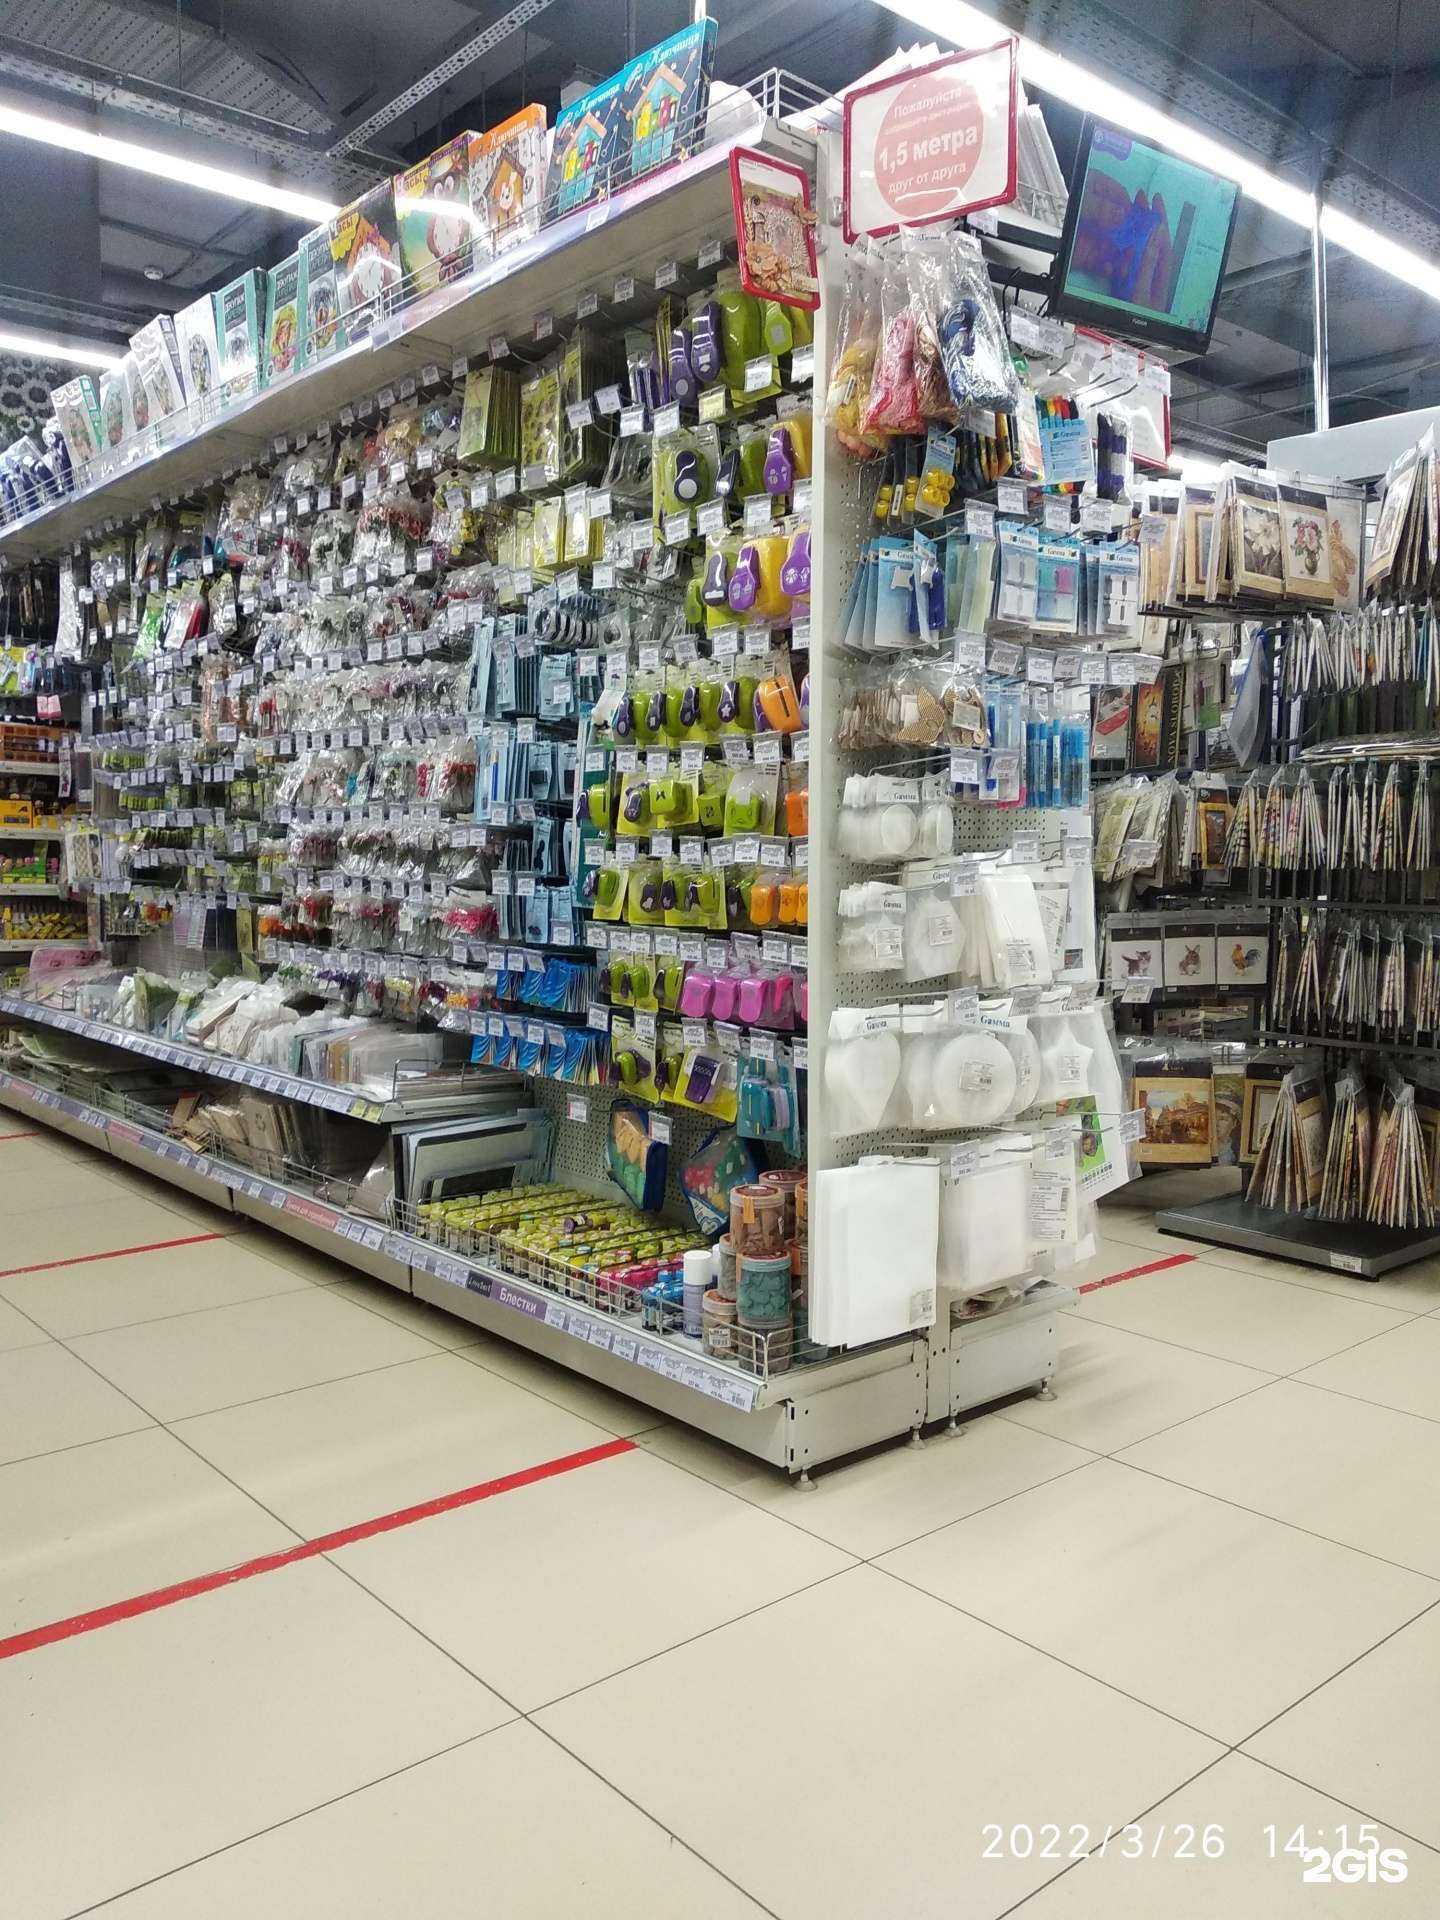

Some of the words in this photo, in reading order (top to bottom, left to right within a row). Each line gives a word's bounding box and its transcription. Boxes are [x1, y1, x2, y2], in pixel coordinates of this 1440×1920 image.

[878, 141, 909, 174] 1,5
[913, 126, 978, 162] метра
[888, 177, 915, 195] друг
[916, 172, 931, 185] от
[931, 162, 967, 184] друга
[980, 1014, 1011, 1029] Gamma
[499, 1286, 538, 1314] Блестки
